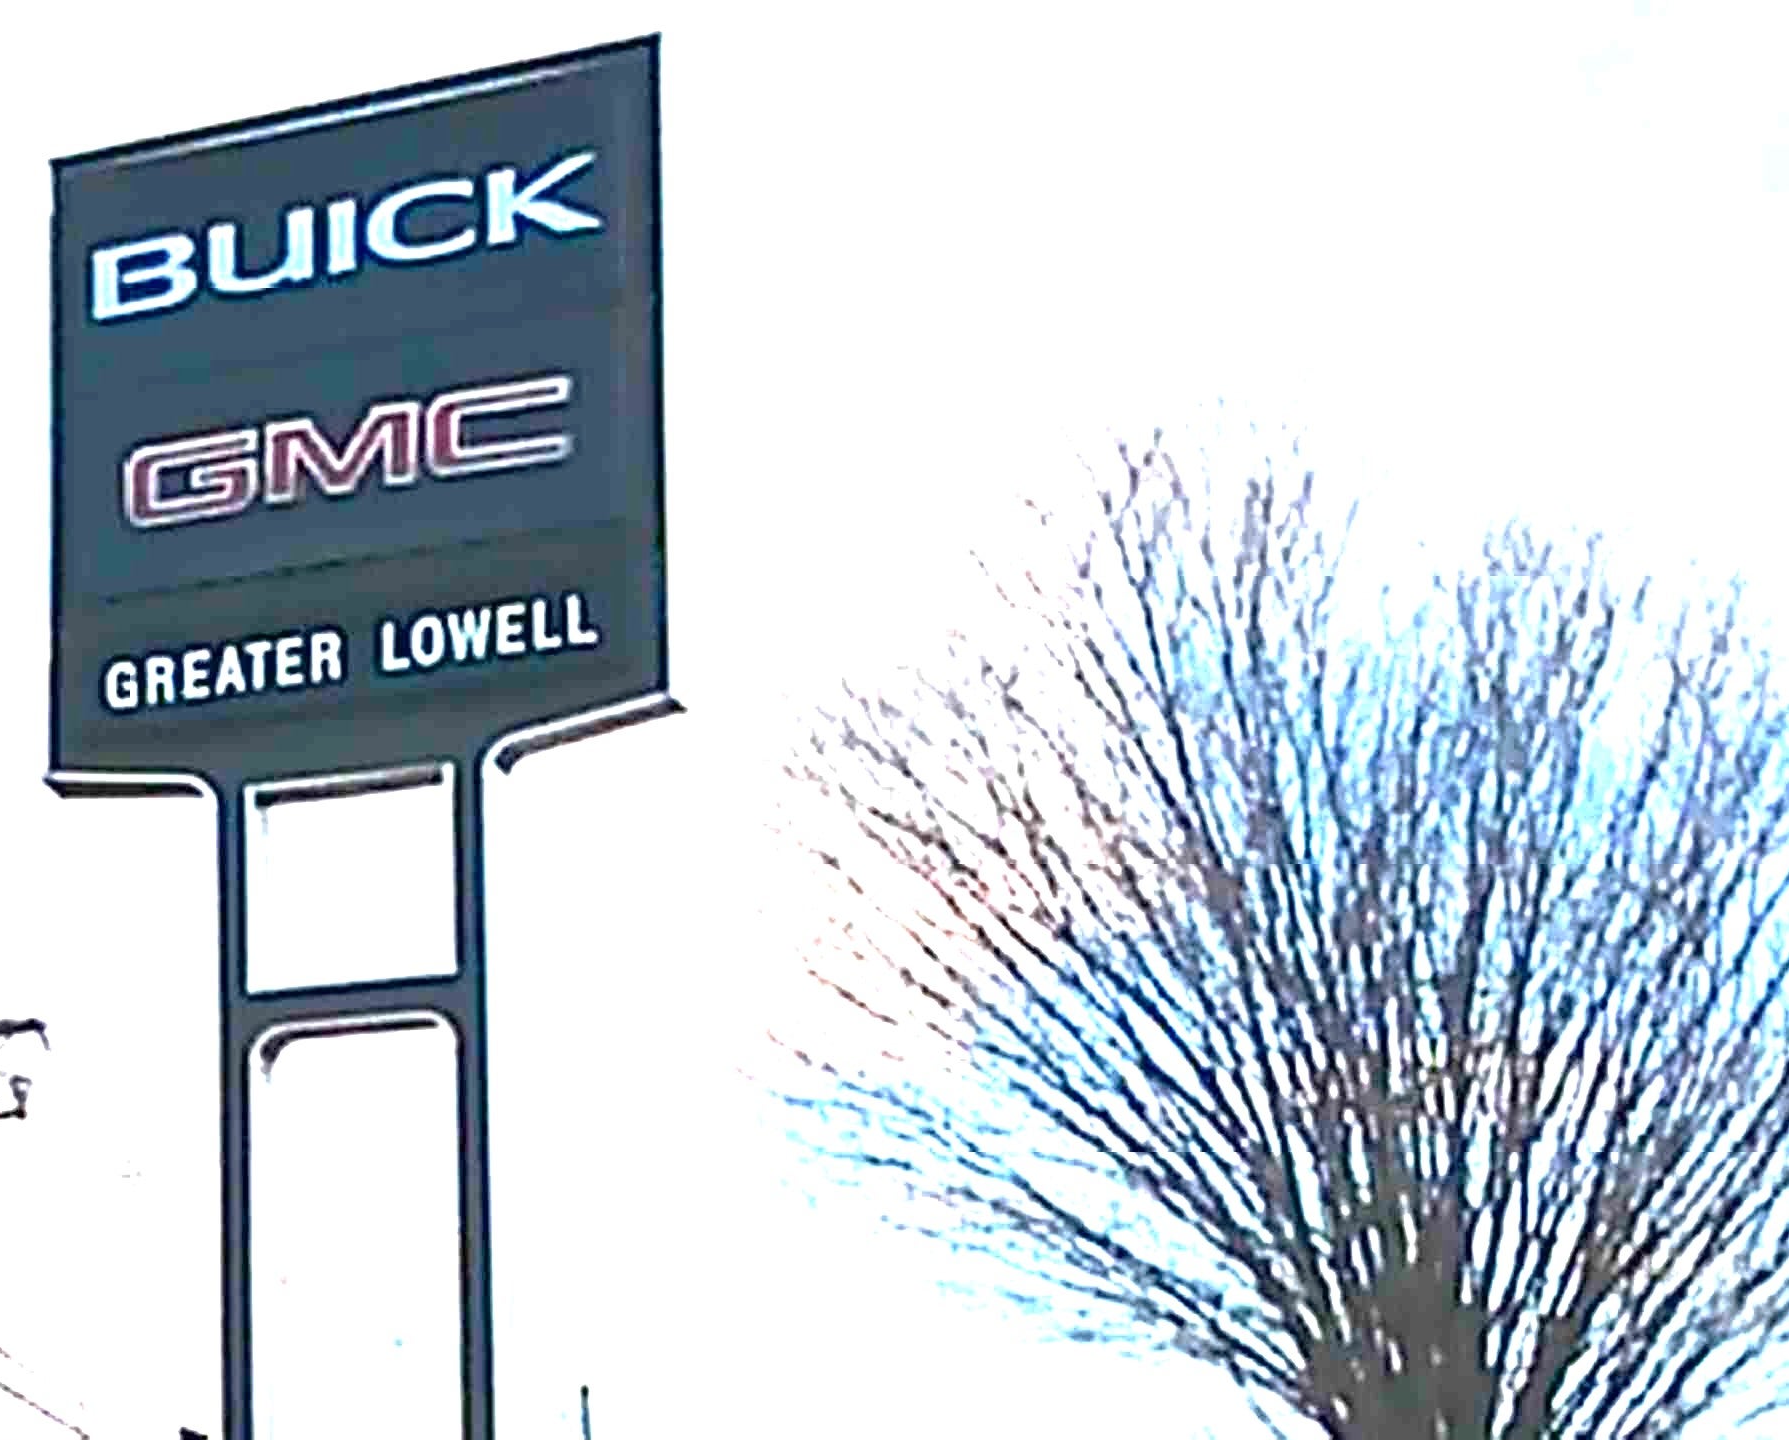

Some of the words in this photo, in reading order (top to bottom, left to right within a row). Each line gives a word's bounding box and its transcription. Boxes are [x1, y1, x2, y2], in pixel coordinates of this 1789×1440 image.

[91, 151, 603, 320] BUICK
[122, 374, 574, 529] GMC
[104, 630, 343, 710] GREATER
[380, 592, 600, 673] LOWELL
